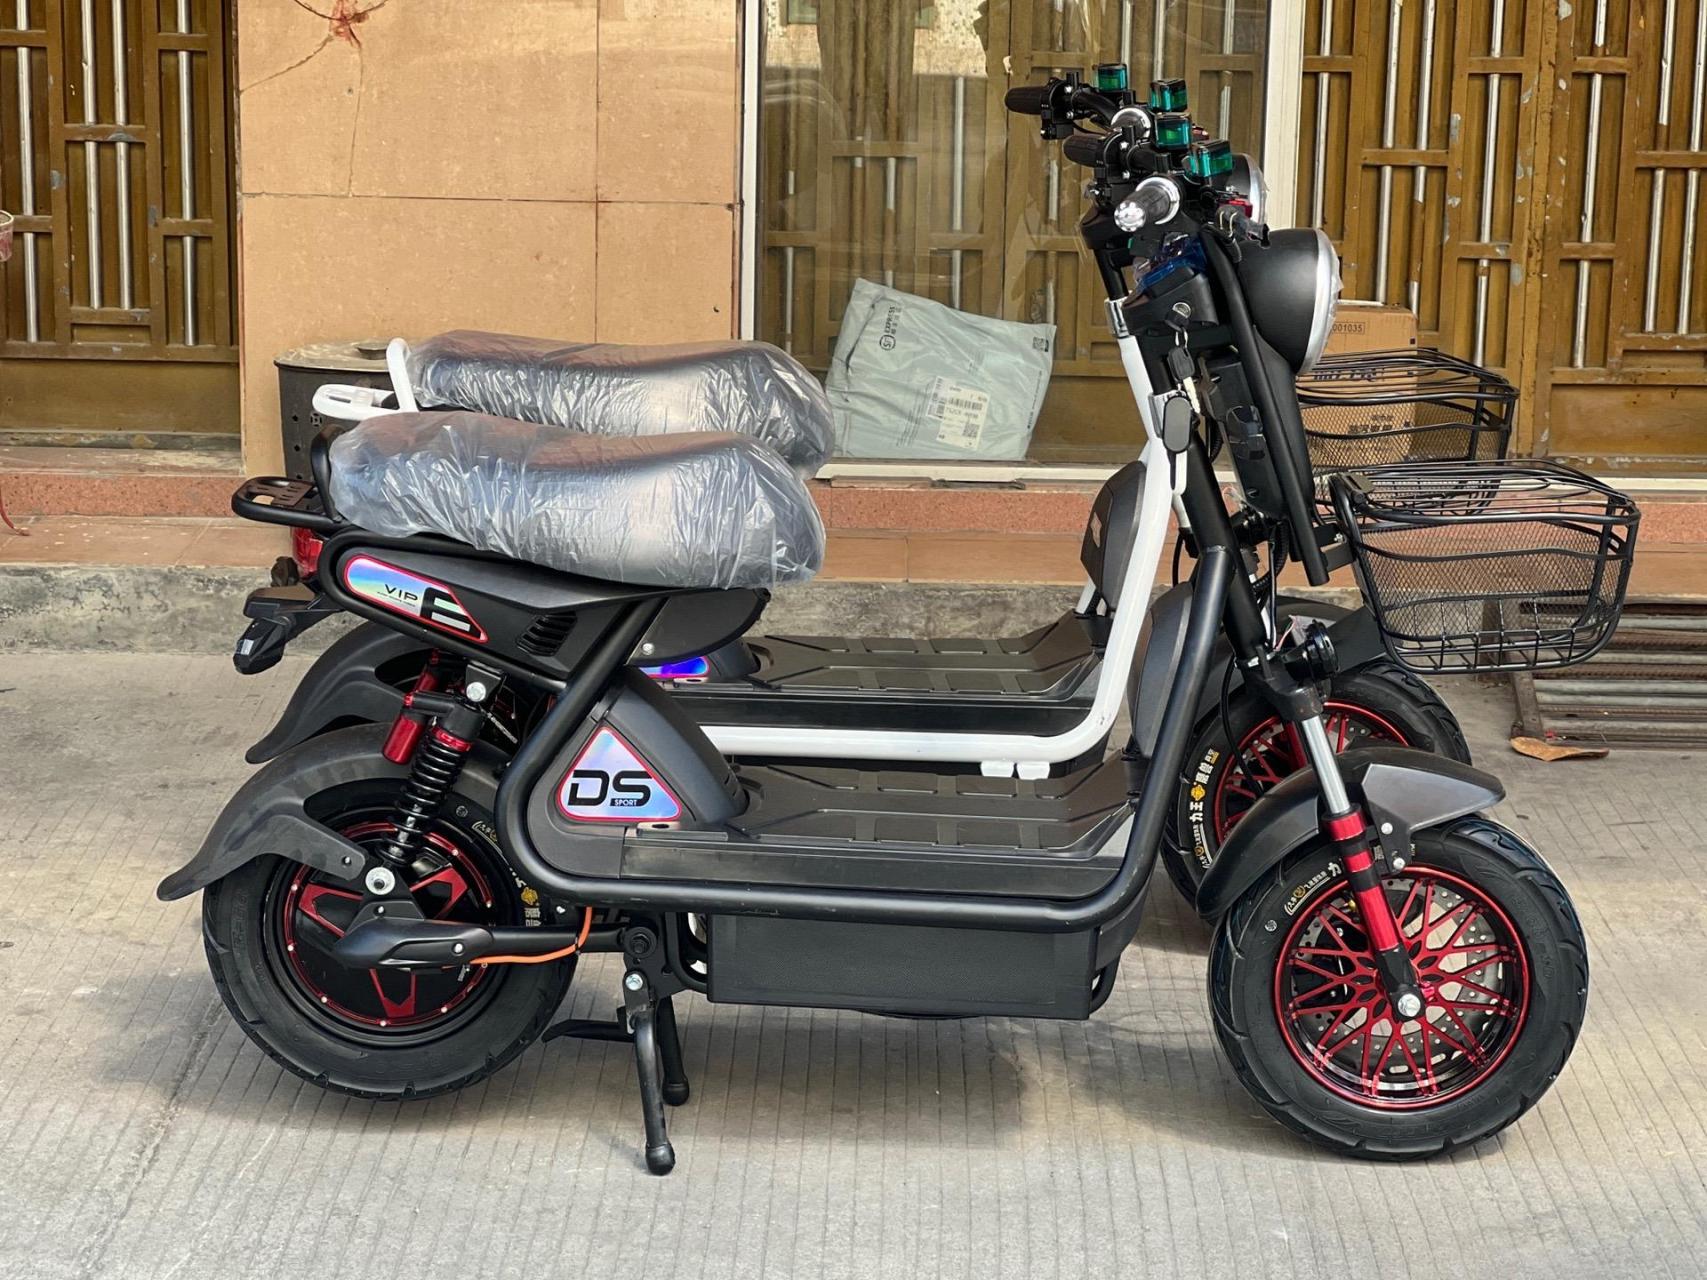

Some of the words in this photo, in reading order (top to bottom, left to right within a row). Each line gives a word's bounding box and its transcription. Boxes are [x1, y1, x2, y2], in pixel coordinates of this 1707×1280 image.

[884, 306, 896, 333] EXPRESS
[1332, 323, 1363, 333] 001035
[385, 583, 418, 601] VIP
[567, 769, 653, 807] DS
[614, 799, 638, 807] SPORT
